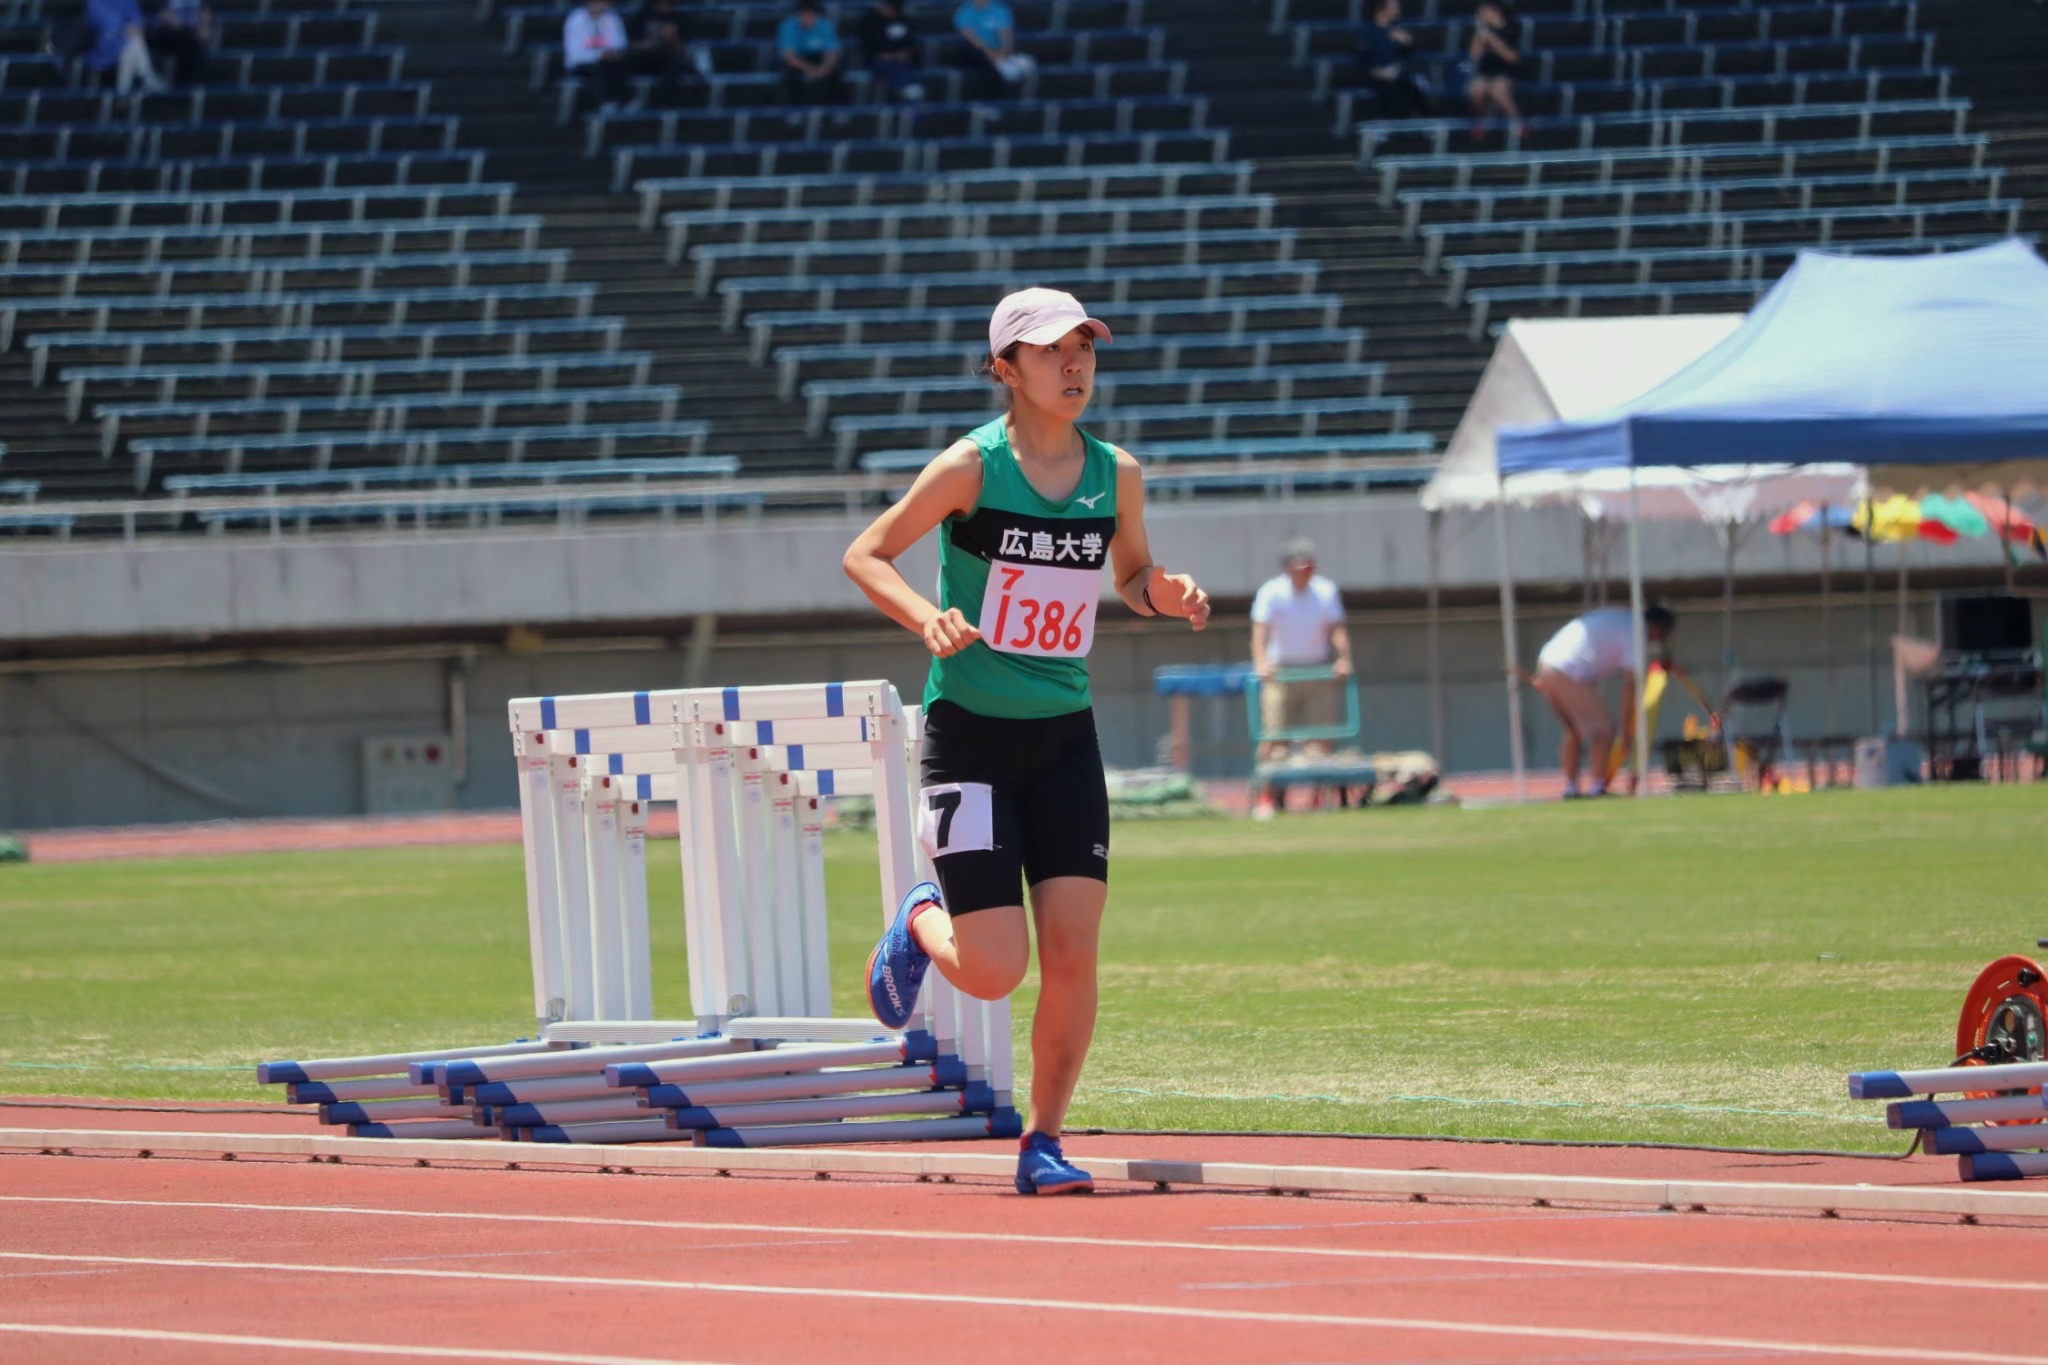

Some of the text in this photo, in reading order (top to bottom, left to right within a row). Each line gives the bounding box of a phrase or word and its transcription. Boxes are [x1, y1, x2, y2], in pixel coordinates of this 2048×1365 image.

[999, 528, 1103, 562] 広島大学
[1000, 567, 1025, 591] 7
[992, 594, 1087, 651] 1386
[928, 791, 962, 850] 7
[881, 964, 906, 1017] BROOKS
